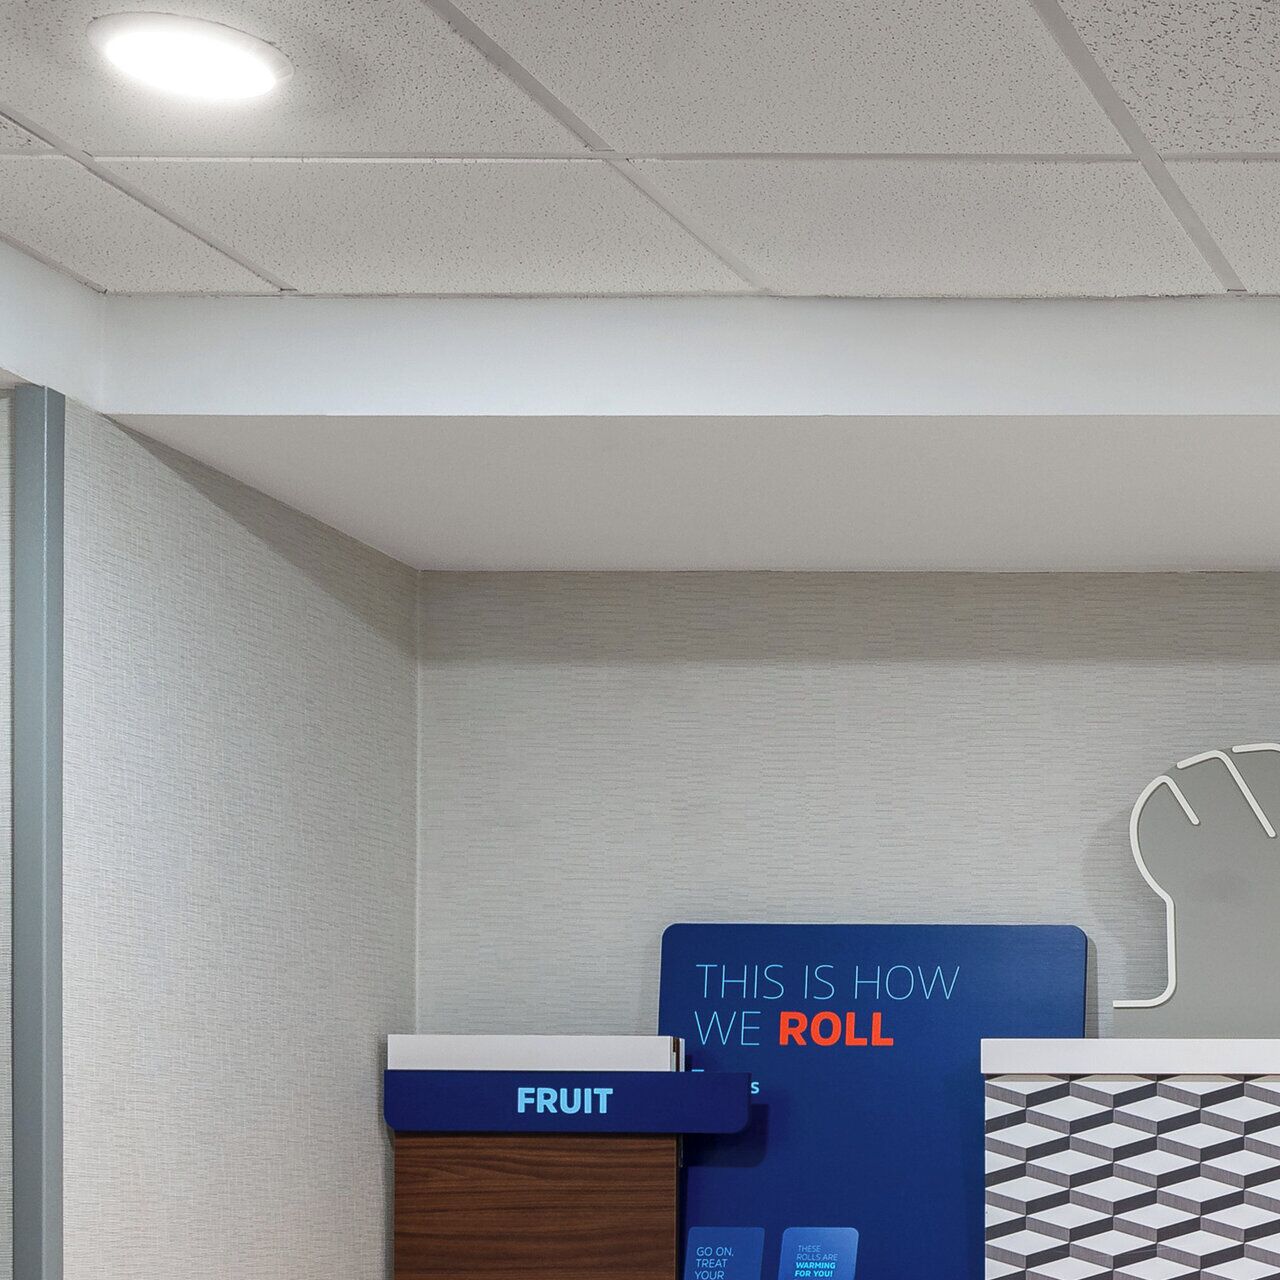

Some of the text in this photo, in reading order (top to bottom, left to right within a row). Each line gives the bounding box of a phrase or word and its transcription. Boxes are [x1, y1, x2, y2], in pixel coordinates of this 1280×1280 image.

[696, 963, 960, 1000] THIS IS HOW
[694, 1010, 894, 1046] WE ROLL
[517, 1087, 614, 1114] FRUIT
[696, 1246, 713, 1257] GO
[798, 1244, 821, 1252] THESE
[796, 1253, 839, 1261] ROLLS ARE
[696, 1258, 728, 1269] TREAT
[795, 1261, 836, 1269] WARMING
[694, 1270, 725, 1280] YOUR
[794, 1270, 834, 1278] FOR YOU!
